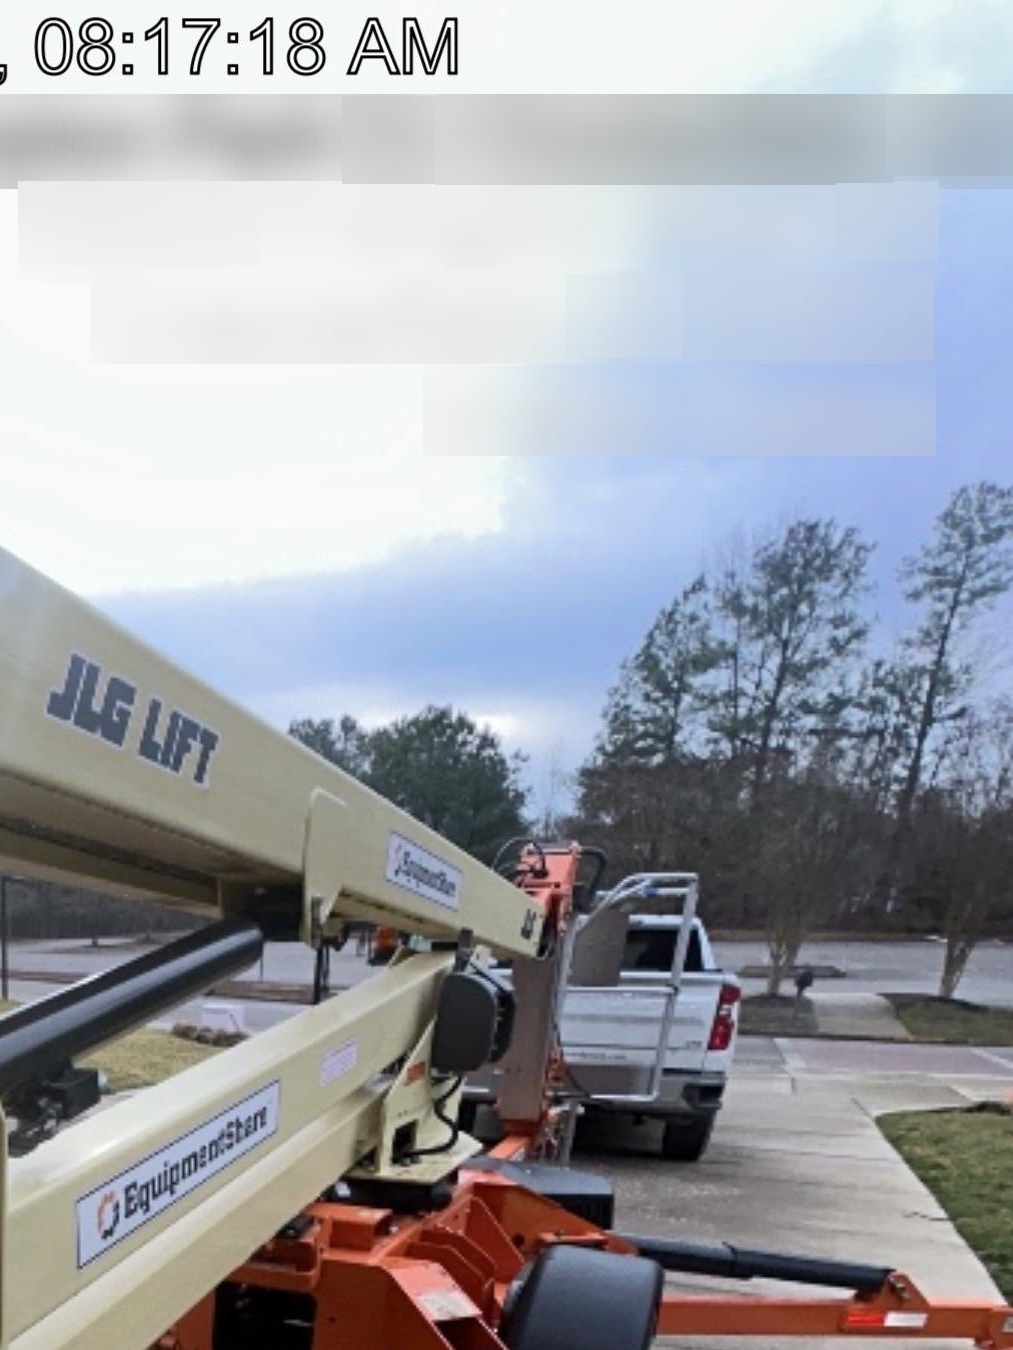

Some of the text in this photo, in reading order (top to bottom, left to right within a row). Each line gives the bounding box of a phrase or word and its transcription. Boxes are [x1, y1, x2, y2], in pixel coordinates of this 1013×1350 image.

[46, 653, 220, 785] JLG LIFT
[123, 1105, 268, 1220] EquipmentShare
